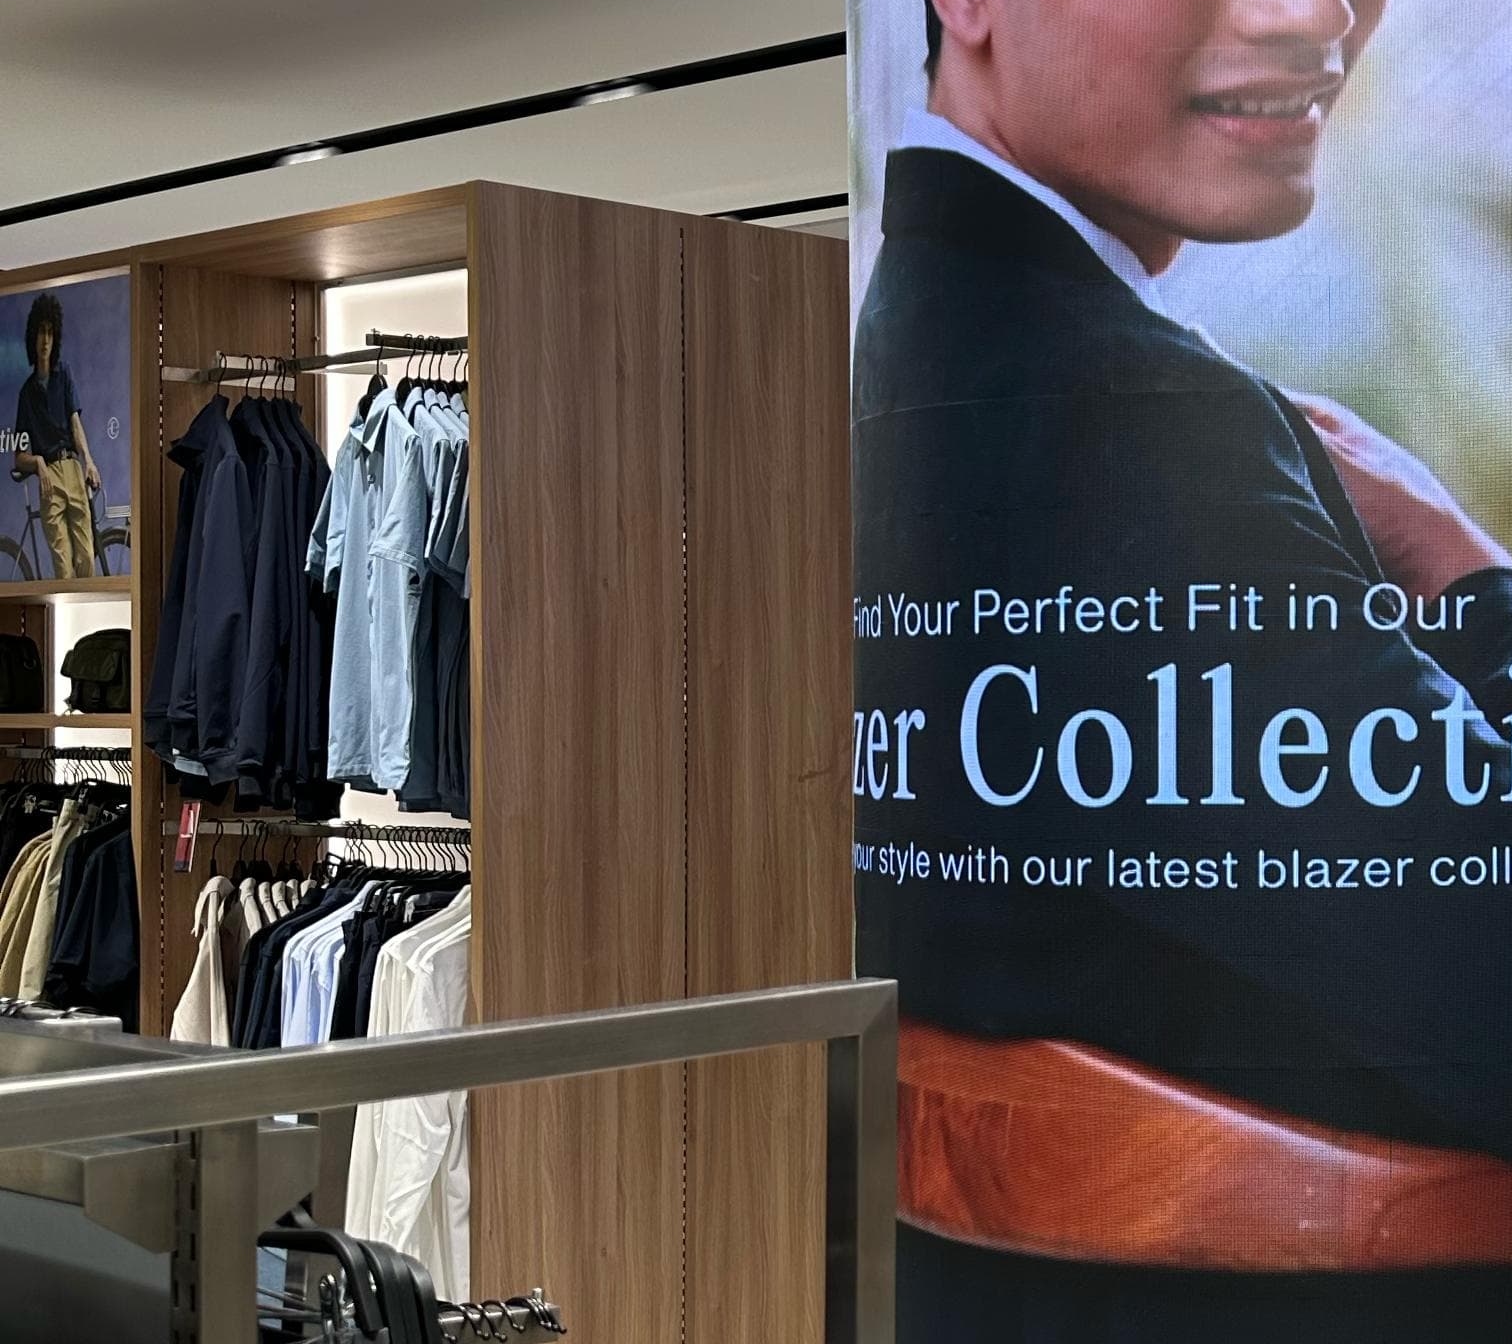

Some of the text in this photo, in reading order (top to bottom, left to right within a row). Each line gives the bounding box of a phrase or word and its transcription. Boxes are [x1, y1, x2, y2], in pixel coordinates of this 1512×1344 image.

[888, 592, 960, 637] Your
[974, 584, 1164, 634] Perfect
[1188, 583, 1264, 631] Fit
[1288, 582, 1339, 630] in
[1362, 581, 1477, 632] Our
[879, 840, 931, 885] style
[939, 844, 1009, 885] with
[1022, 856, 1092, 887] our
[1107, 848, 1238, 889] latest
[1258, 848, 1414, 889] blazer
